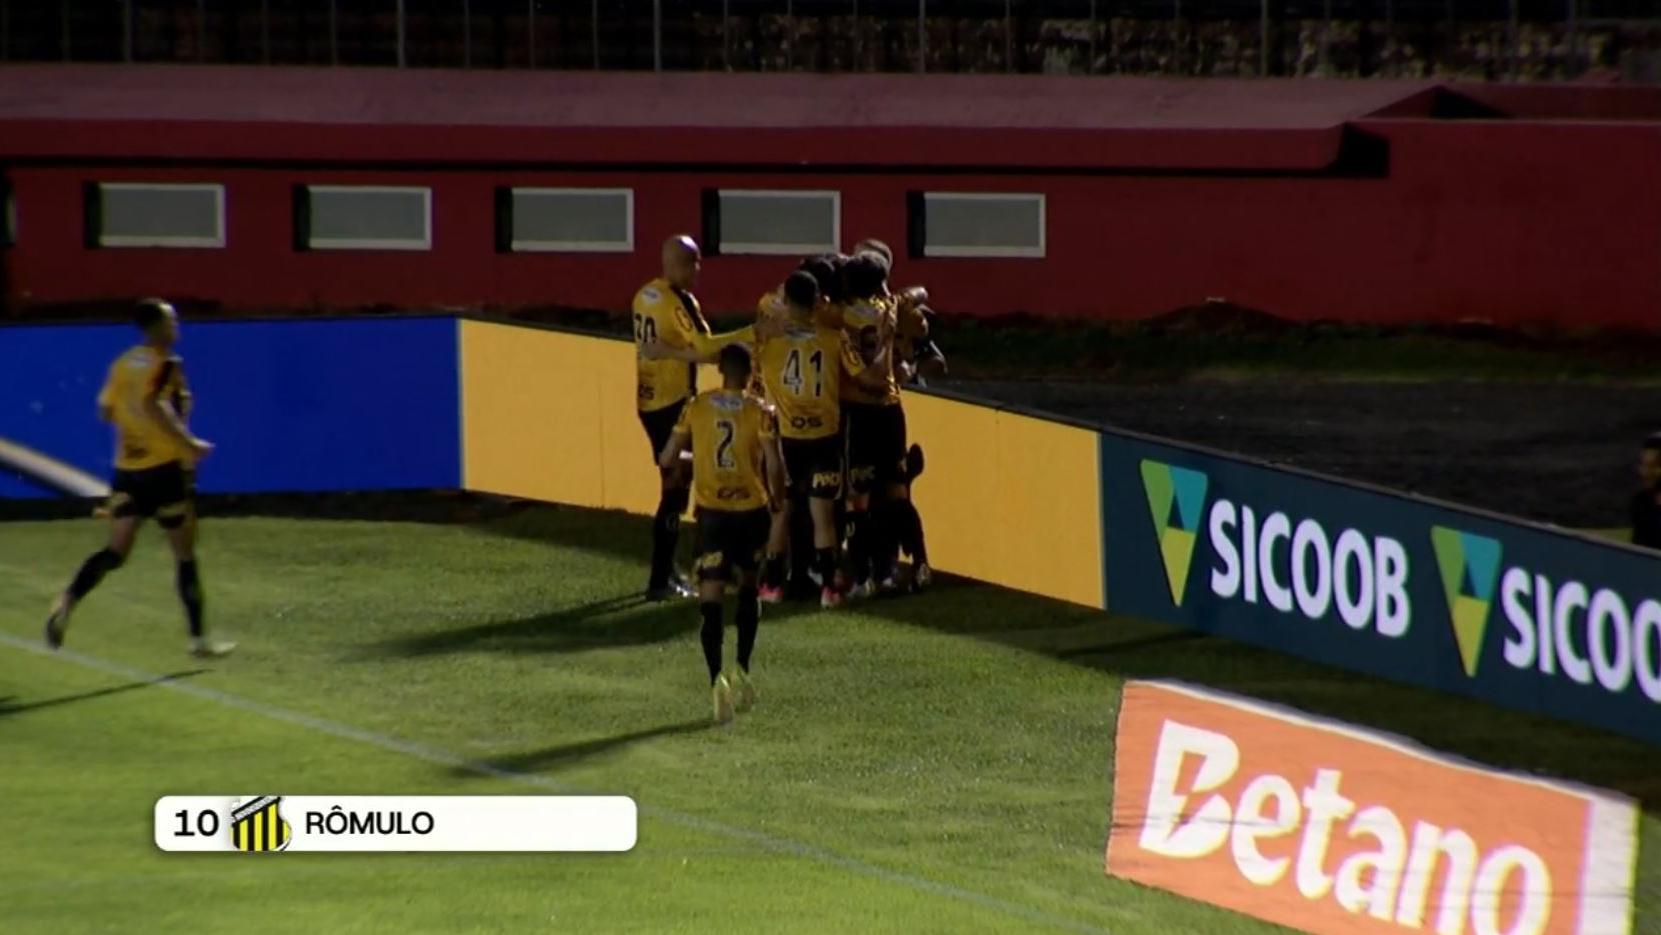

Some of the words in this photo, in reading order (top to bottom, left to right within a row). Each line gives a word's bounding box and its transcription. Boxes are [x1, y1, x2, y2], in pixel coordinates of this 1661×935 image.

[781, 347, 824, 398] 41
[714, 419, 736, 470] 2
[1208, 498, 1412, 638] SICOOB
[1138, 718, 1553, 935] Betano
